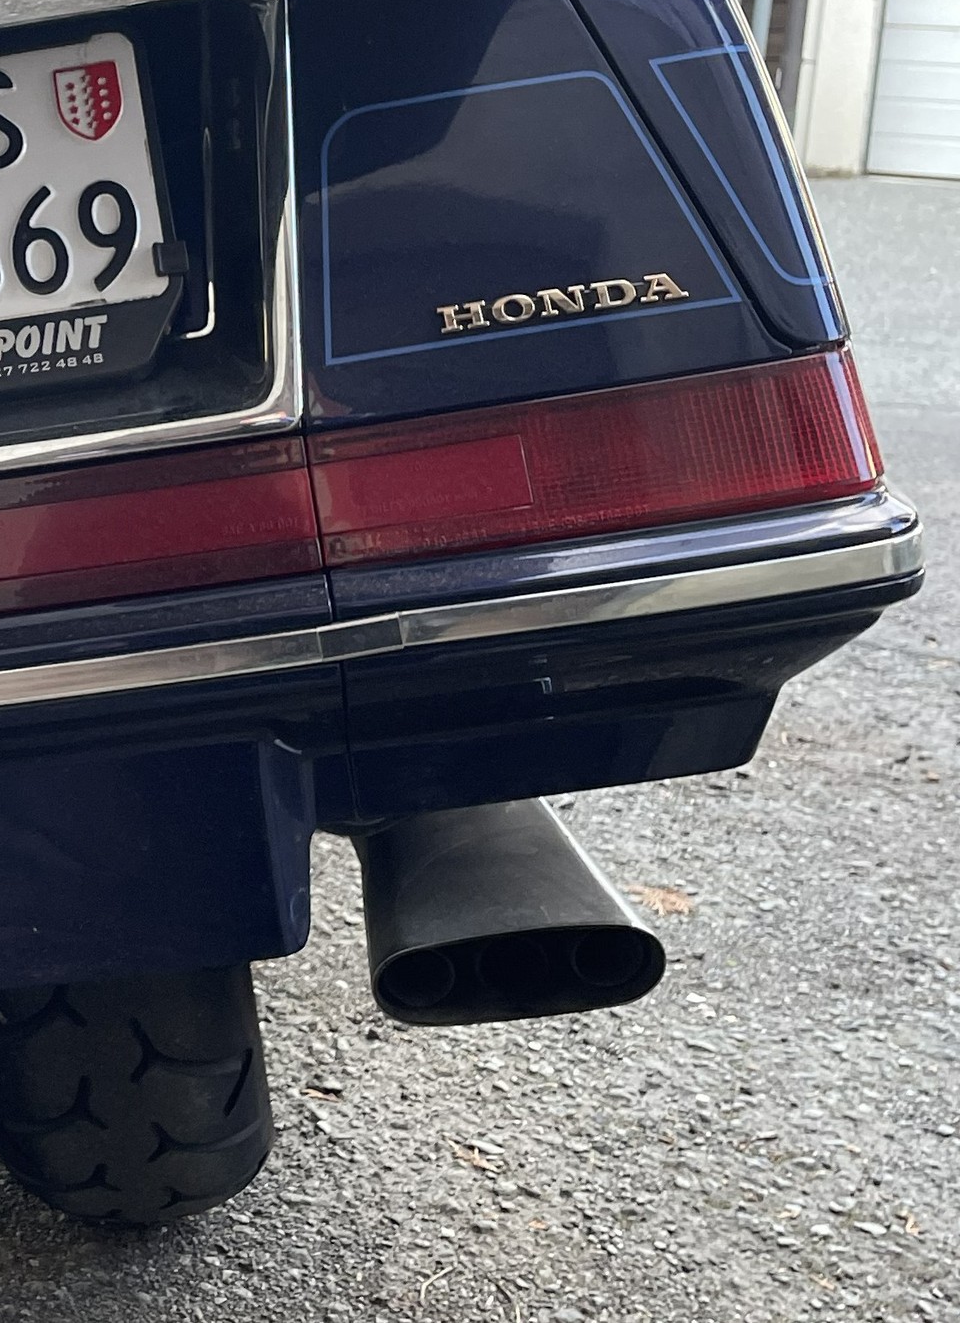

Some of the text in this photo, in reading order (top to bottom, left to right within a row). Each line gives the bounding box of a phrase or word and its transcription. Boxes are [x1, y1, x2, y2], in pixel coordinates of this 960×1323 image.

[436, 272, 690, 334] HONDA
[18, 361, 51, 375] 722
[56, 357, 78, 369] 48
[82, 353, 104, 365] 48
